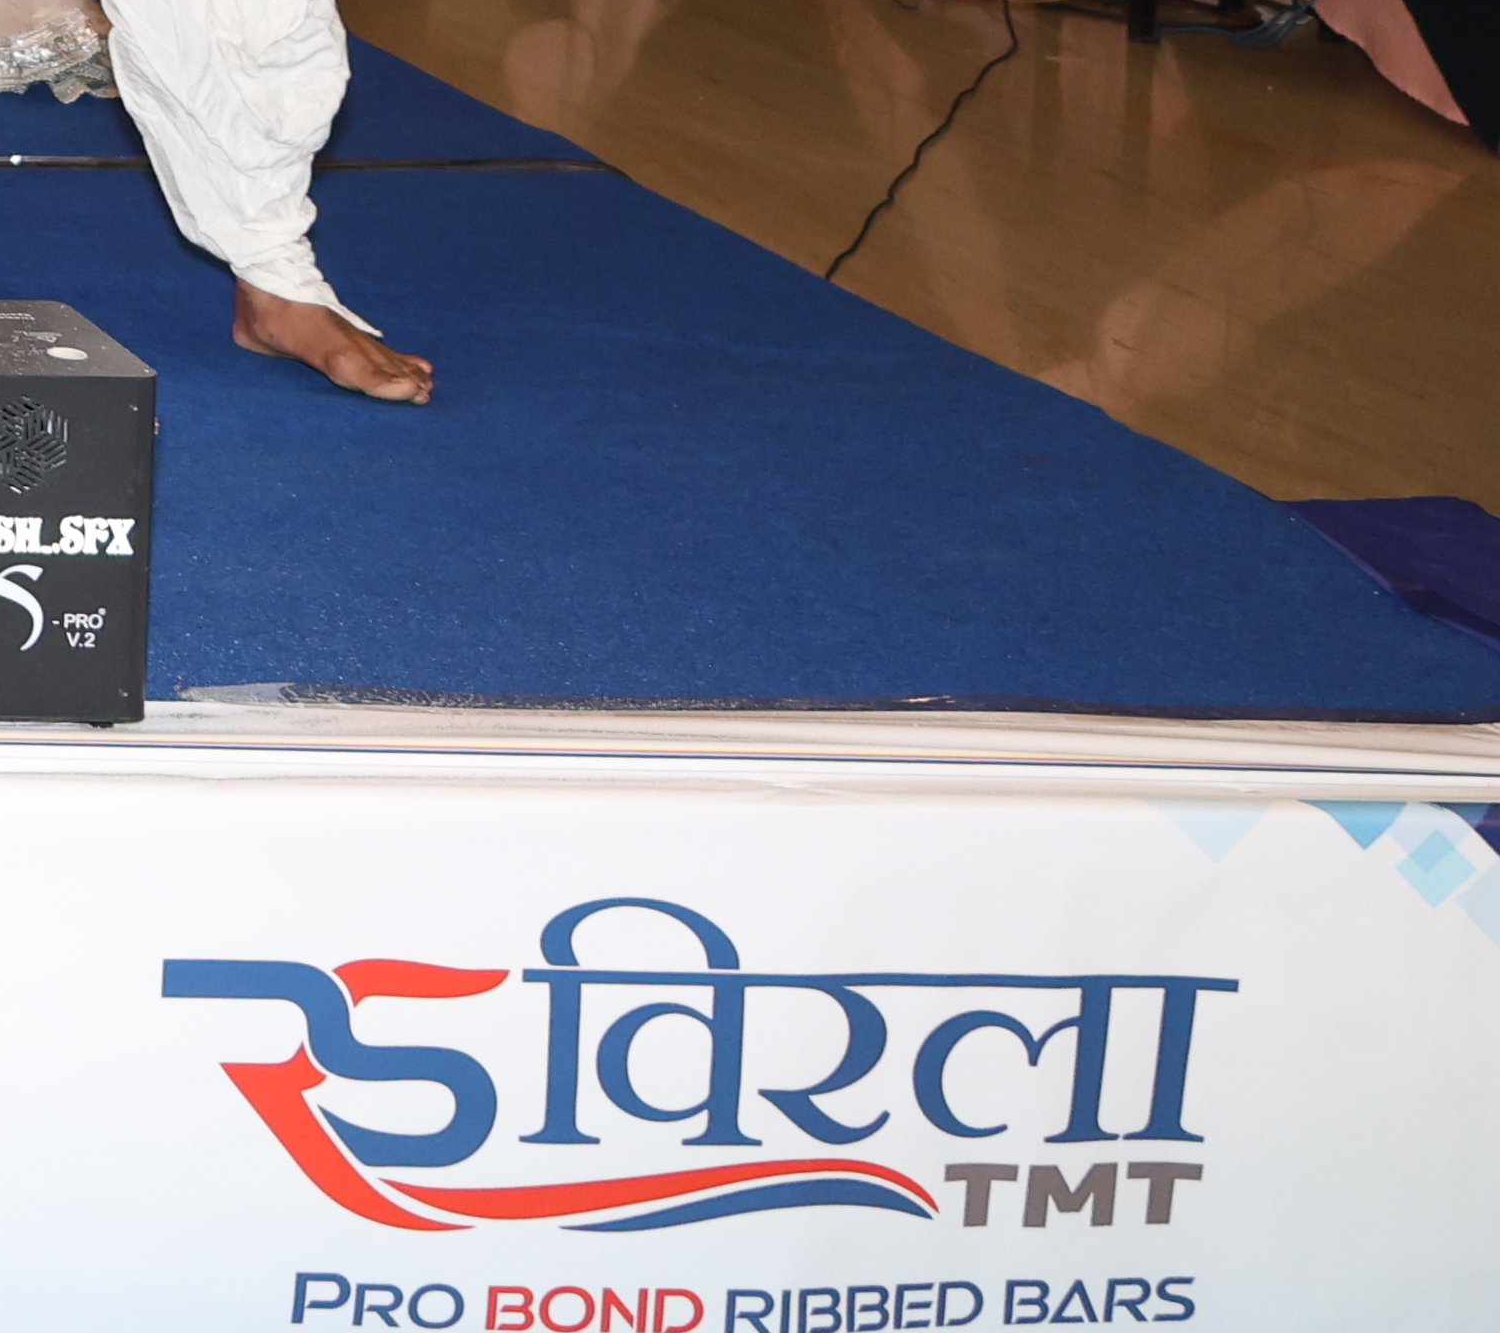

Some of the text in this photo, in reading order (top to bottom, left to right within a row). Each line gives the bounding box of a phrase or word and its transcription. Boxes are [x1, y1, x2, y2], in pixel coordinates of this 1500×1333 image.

[66, 633, 96, 648] V.2
[943, 1161, 1204, 1229] TMT
[290, 1271, 1197, 1333] PRO BOND RIBBED BARS
